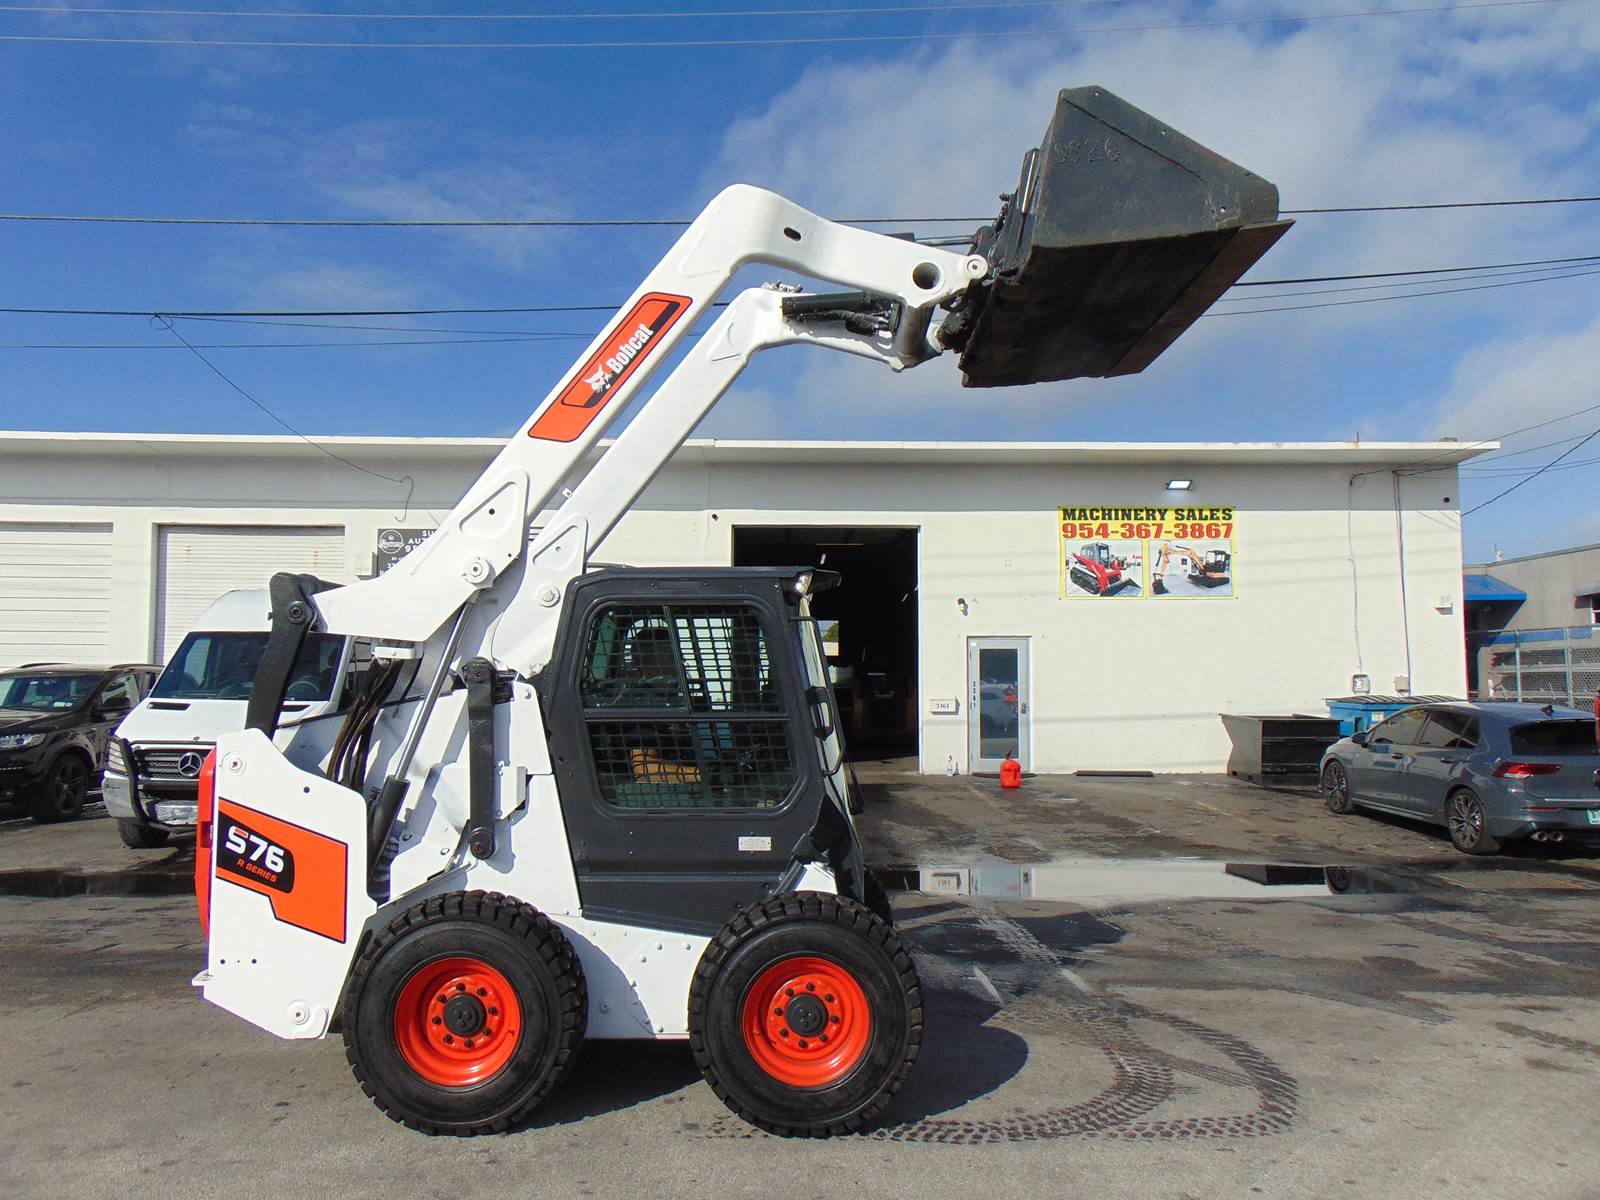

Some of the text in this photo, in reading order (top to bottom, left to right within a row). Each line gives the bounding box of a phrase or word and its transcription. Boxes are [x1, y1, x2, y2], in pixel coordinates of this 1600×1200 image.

[605, 323, 654, 374] Bobcat
[1062, 508, 1233, 521] MACHINERY SALES
[1062, 522, 1234, 539] 954-367-3867
[225, 825, 285, 873] S76
[245, 863, 278, 883] SERIES
